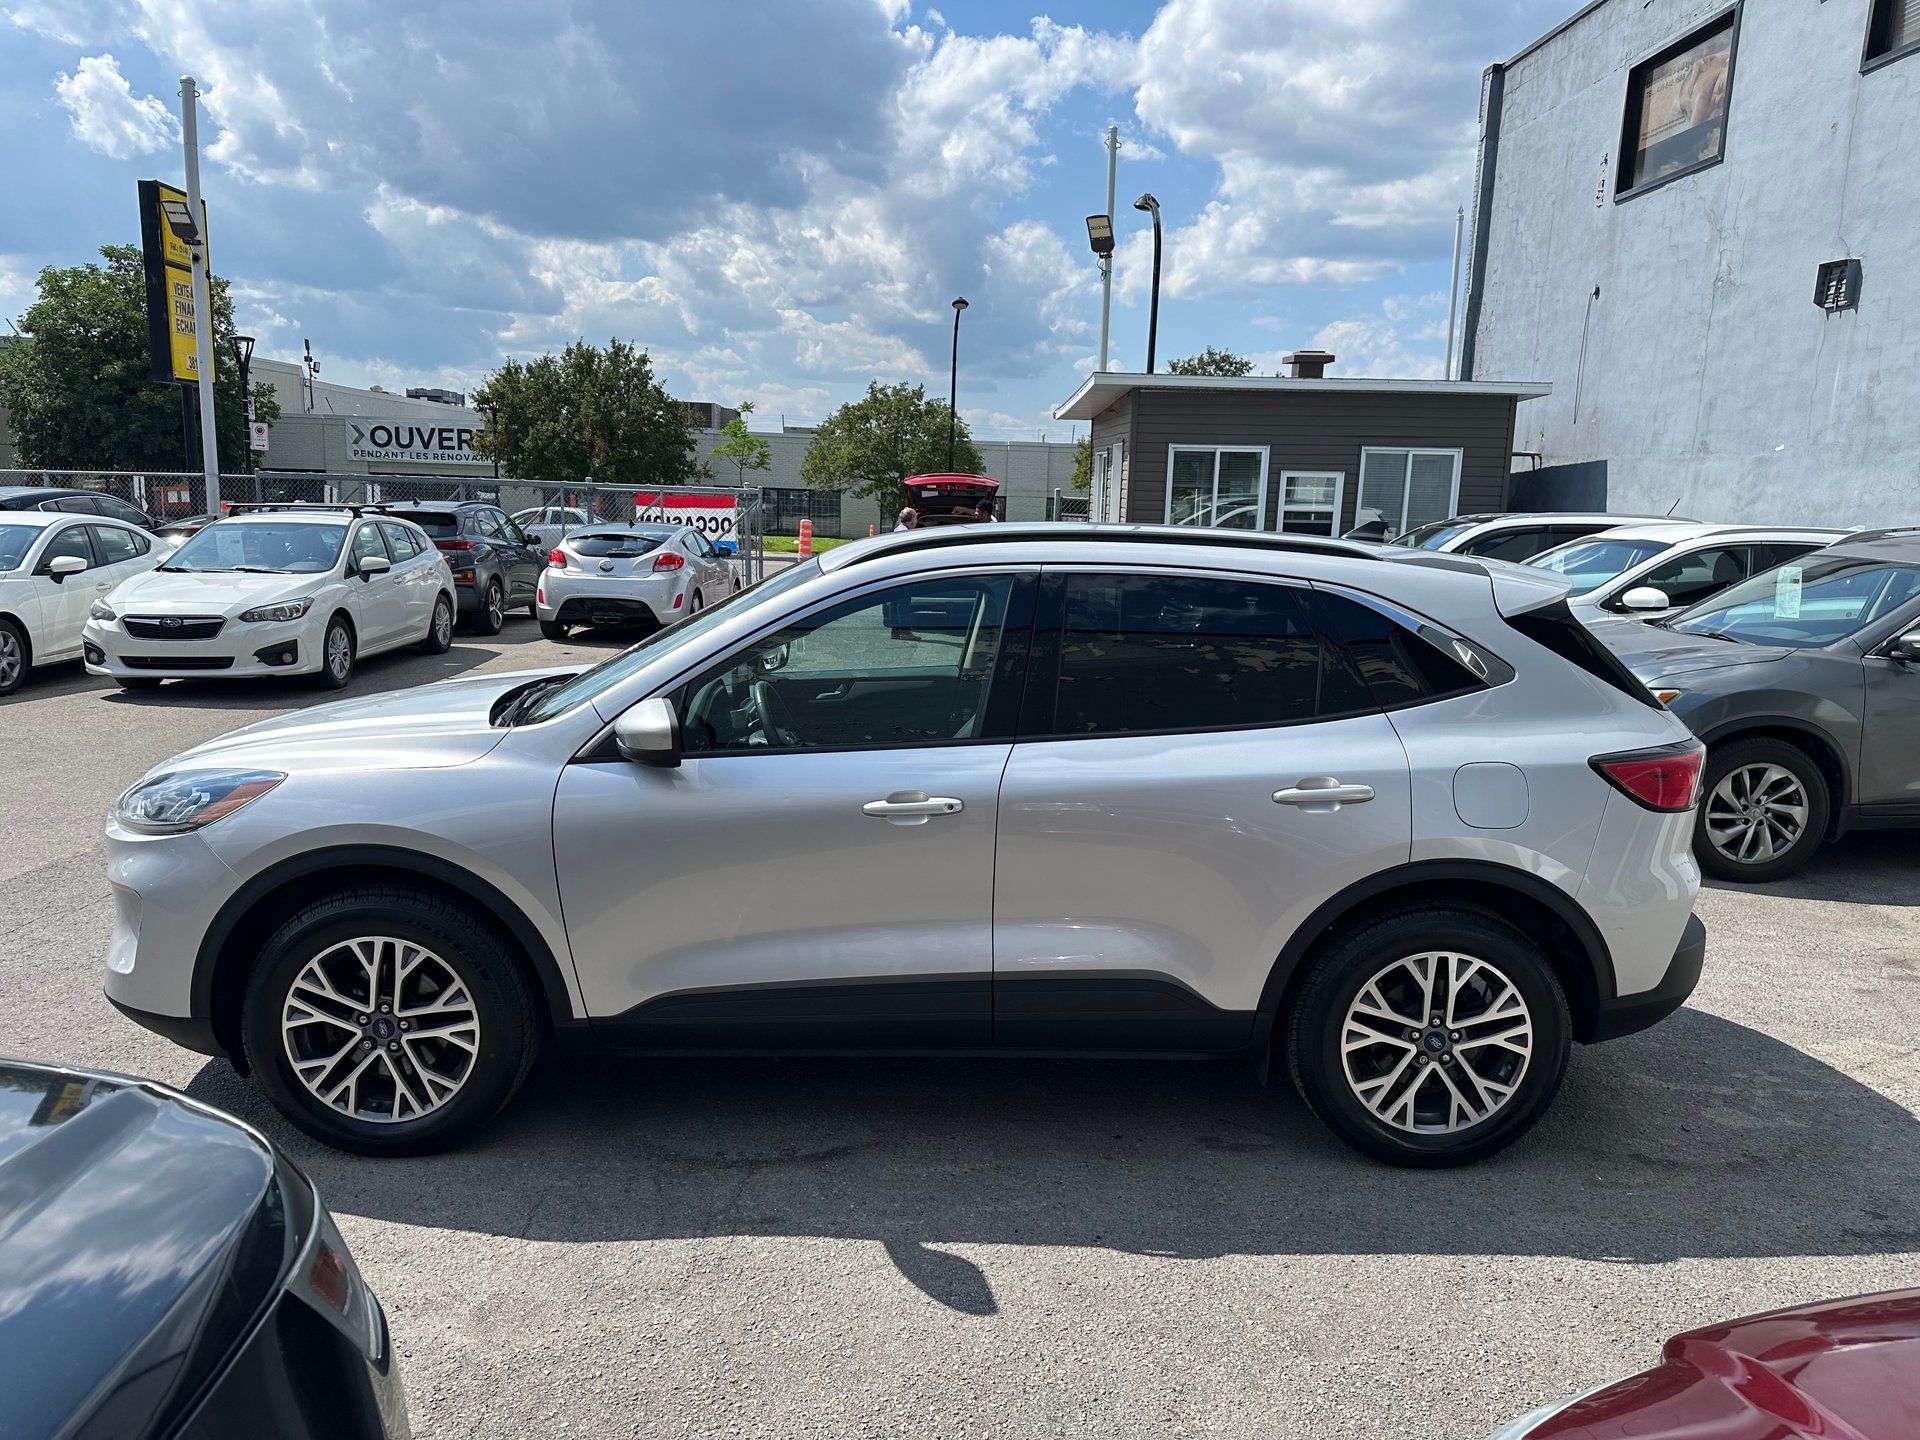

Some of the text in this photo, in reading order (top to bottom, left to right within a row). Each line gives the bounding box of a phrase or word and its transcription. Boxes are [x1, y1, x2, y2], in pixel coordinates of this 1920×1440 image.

[370, 425, 494, 451] OUVER
[353, 450, 405, 459] PENDANT
[409, 452, 429, 460] LES
